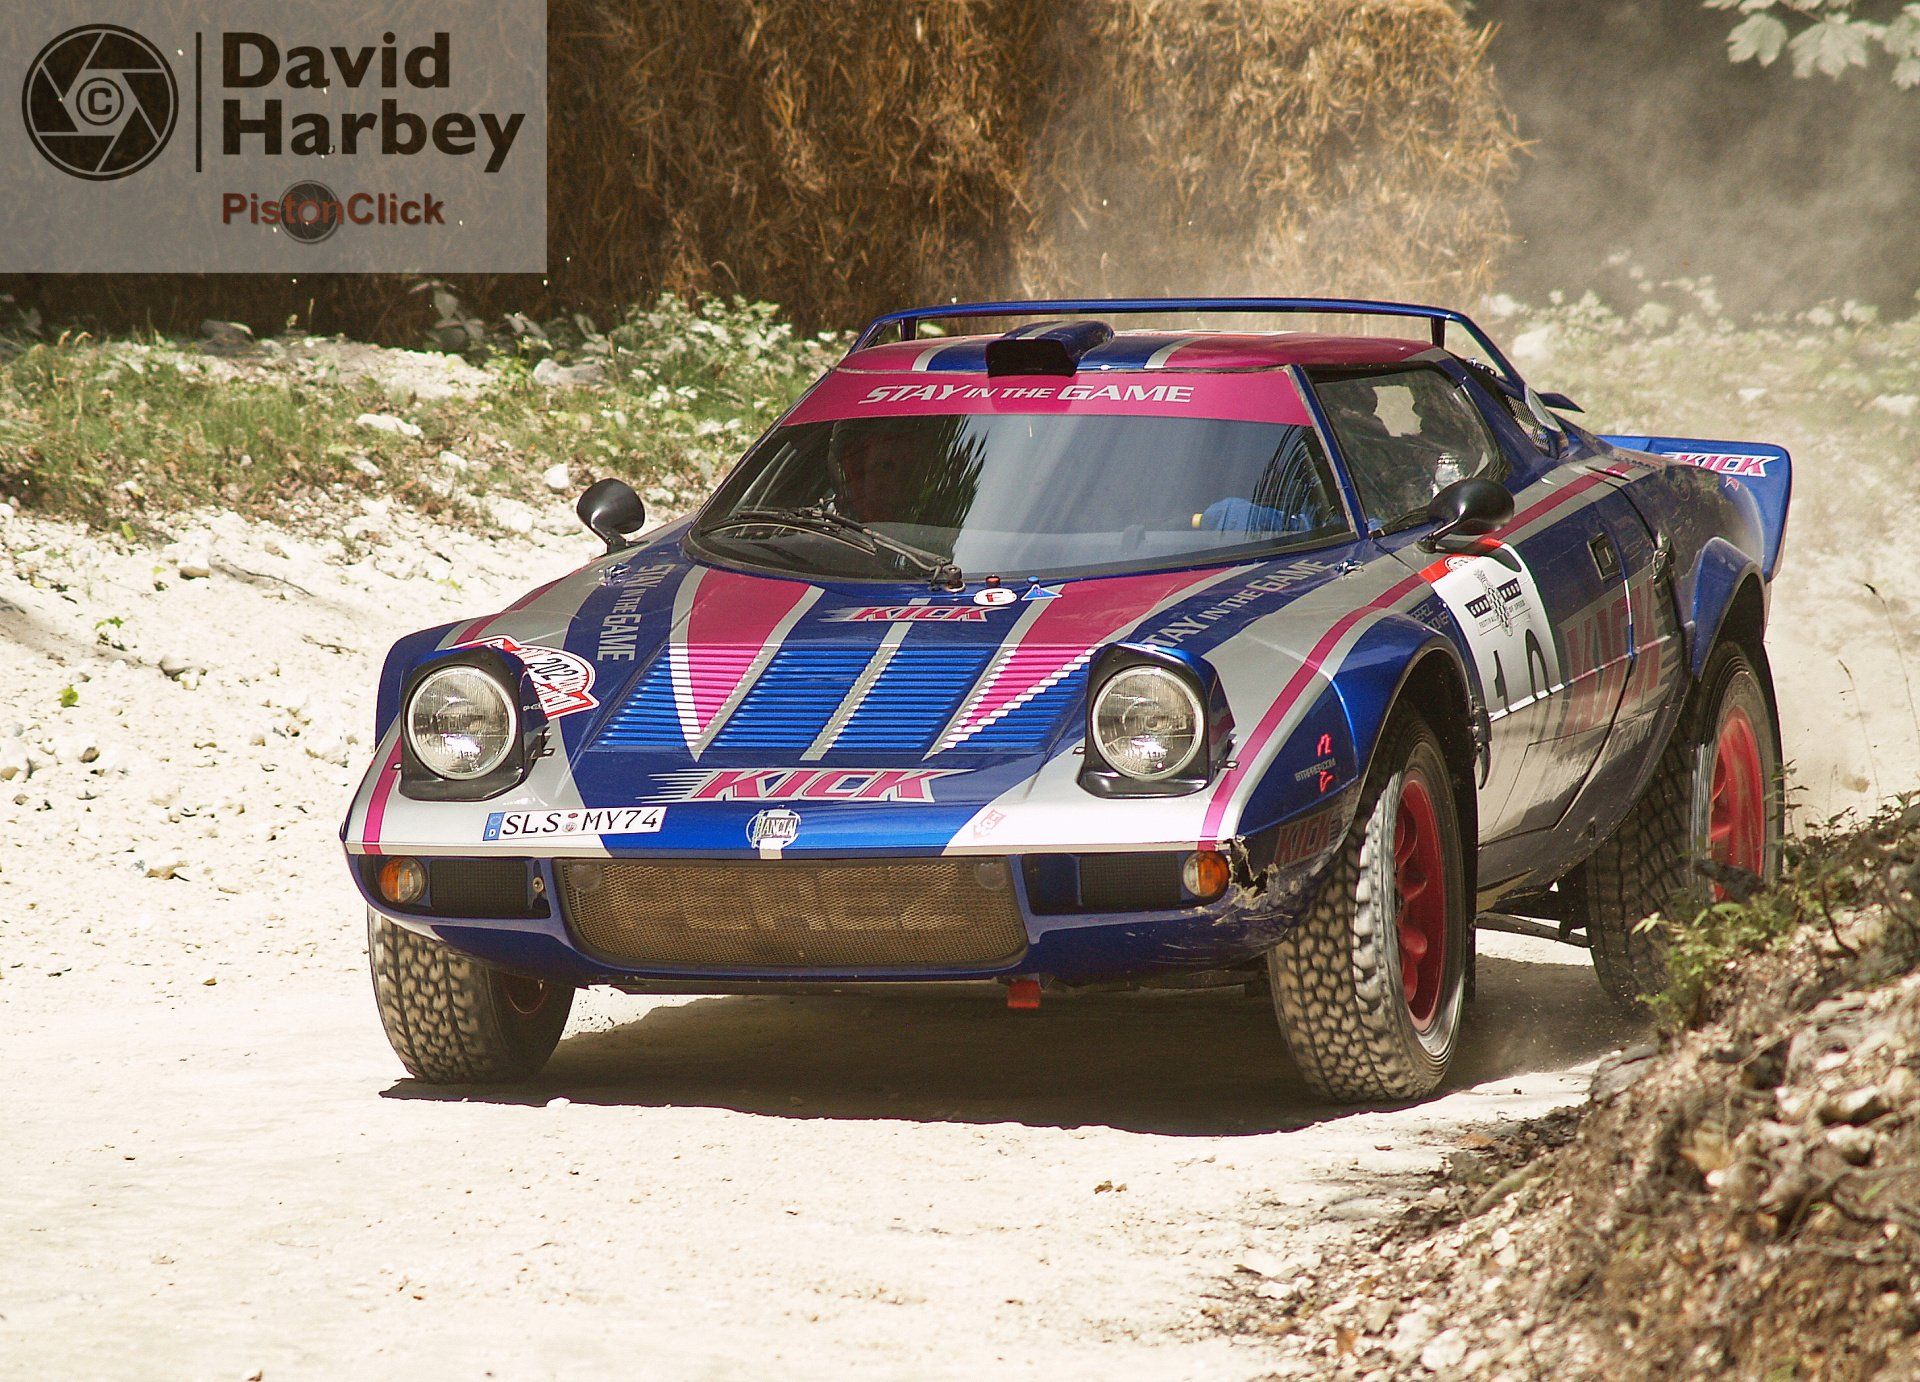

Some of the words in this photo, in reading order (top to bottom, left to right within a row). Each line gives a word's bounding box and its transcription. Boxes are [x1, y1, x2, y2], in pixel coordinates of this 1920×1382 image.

[858, 384, 971, 404] STAY
[963, 386, 1000, 399] IN
[1000, 388, 1055, 400] THE
[1057, 385, 1196, 403] GAME
[1674, 451, 1778, 478] KICK
[1197, 606, 1231, 622] IN
[1218, 588, 1265, 609] THE
[1246, 559, 1335, 593] GAME
[612, 597, 643, 614] THE
[845, 606, 1006, 623] KICK
[597, 613, 642, 661] GAME
[684, 768, 965, 803] KICK
[502, 812, 562, 835] SLS
